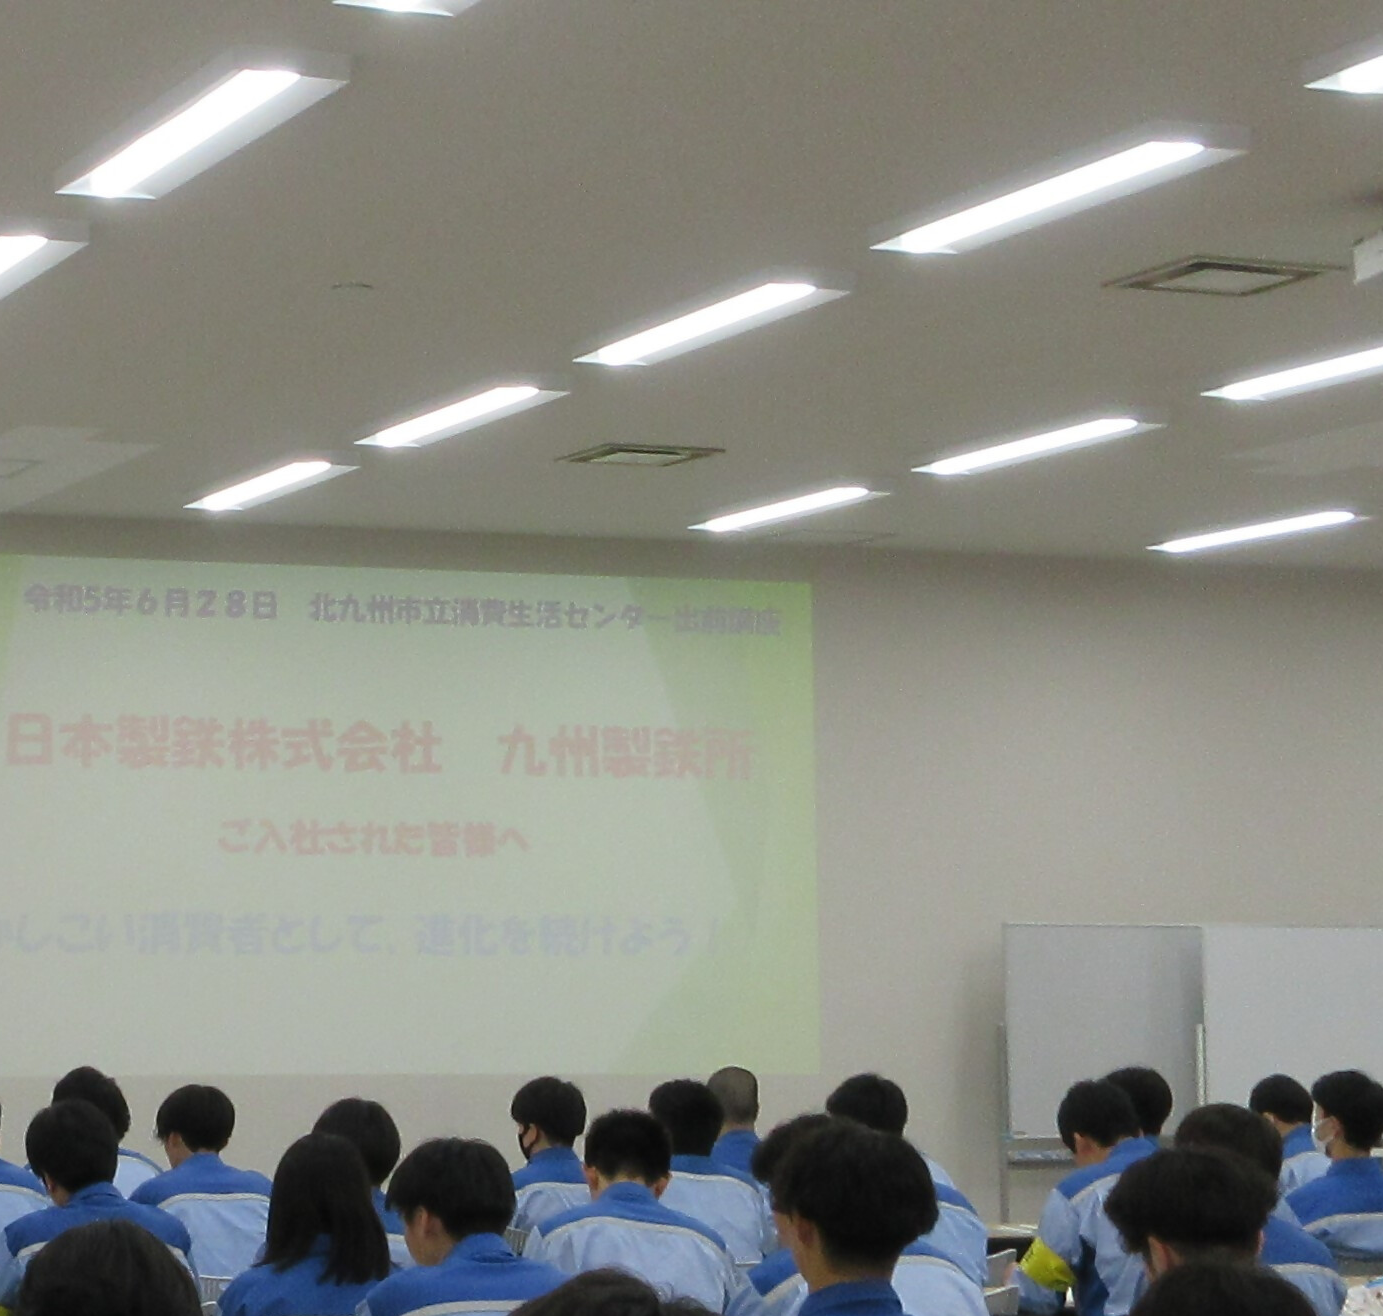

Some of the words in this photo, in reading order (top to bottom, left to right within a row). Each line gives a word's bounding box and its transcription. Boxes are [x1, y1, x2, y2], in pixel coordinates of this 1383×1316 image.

[5, 711, 443, 774] 日本製鉄株式会社
[498, 722, 755, 780] 九州製鉄所
[217, 816, 531, 859] ご入社された皆様へ
